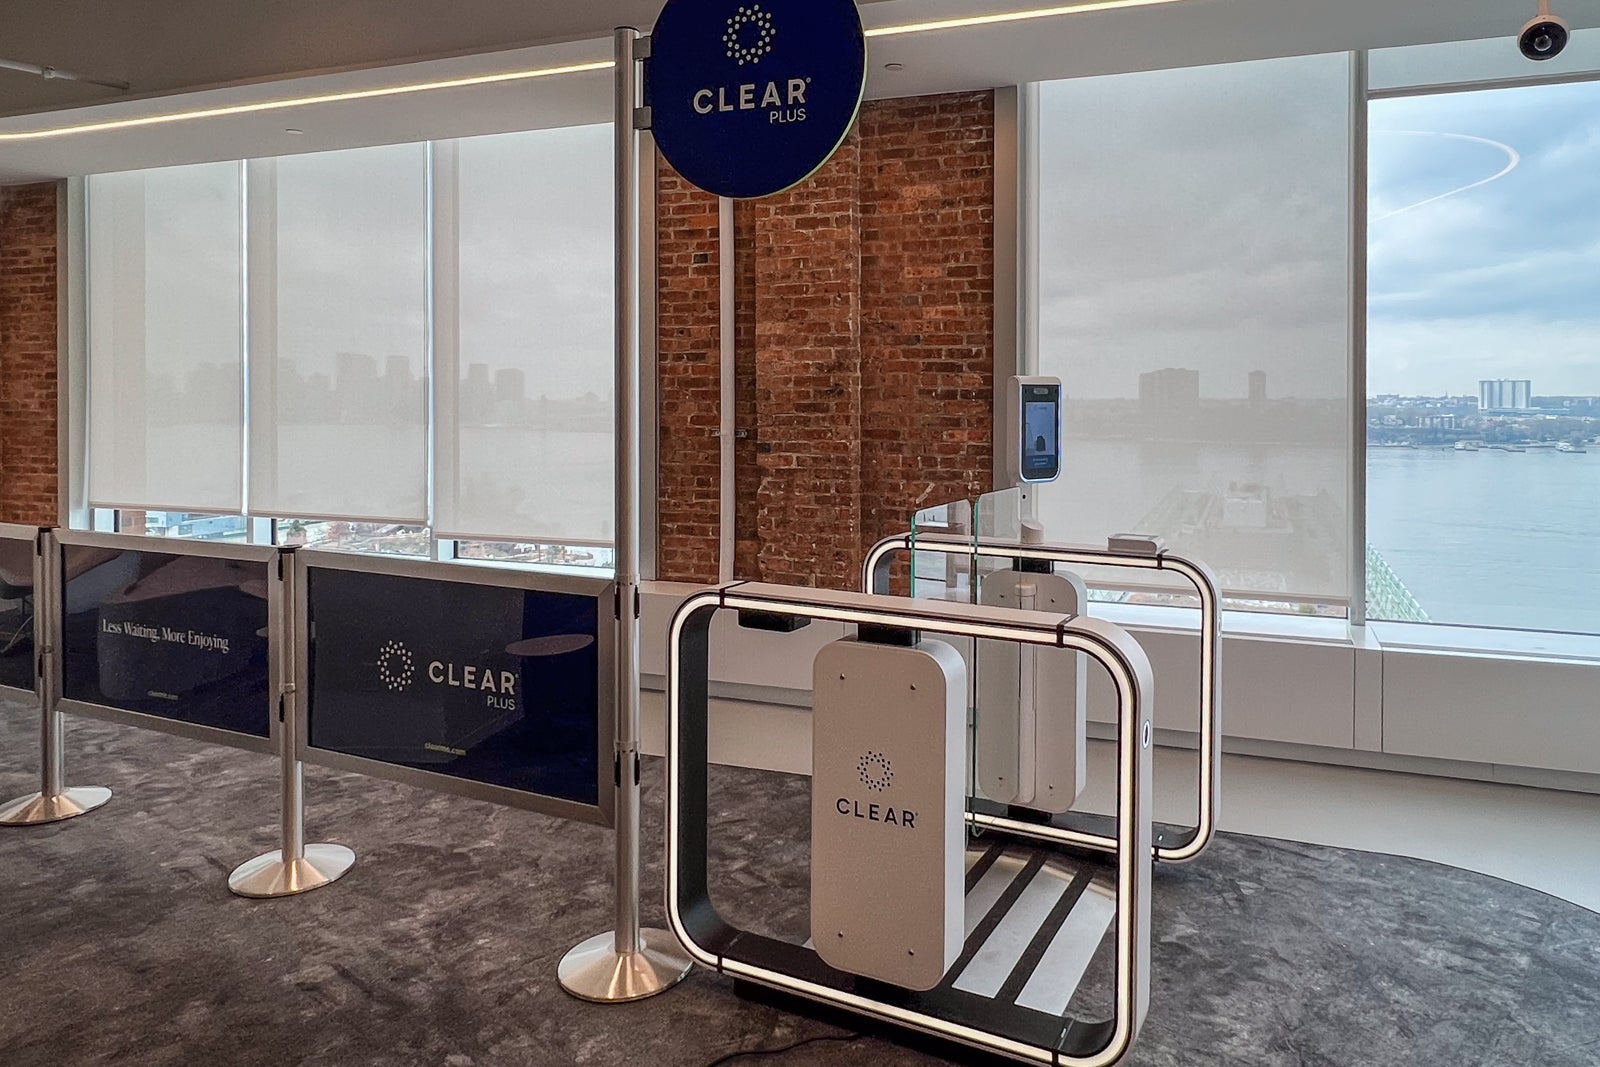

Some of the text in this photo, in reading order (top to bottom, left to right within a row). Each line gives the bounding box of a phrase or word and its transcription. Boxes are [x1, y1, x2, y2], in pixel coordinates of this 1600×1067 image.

[693, 78, 807, 114] CLEAR
[769, 108, 807, 124] PLUS
[102, 618, 122, 634] Less
[162, 626, 186, 644] More
[188, 630, 229, 653] Enjoying
[428, 660, 516, 695] CLEAR
[487, 695, 516, 711] PLUS
[836, 798, 916, 829] CLEAR
